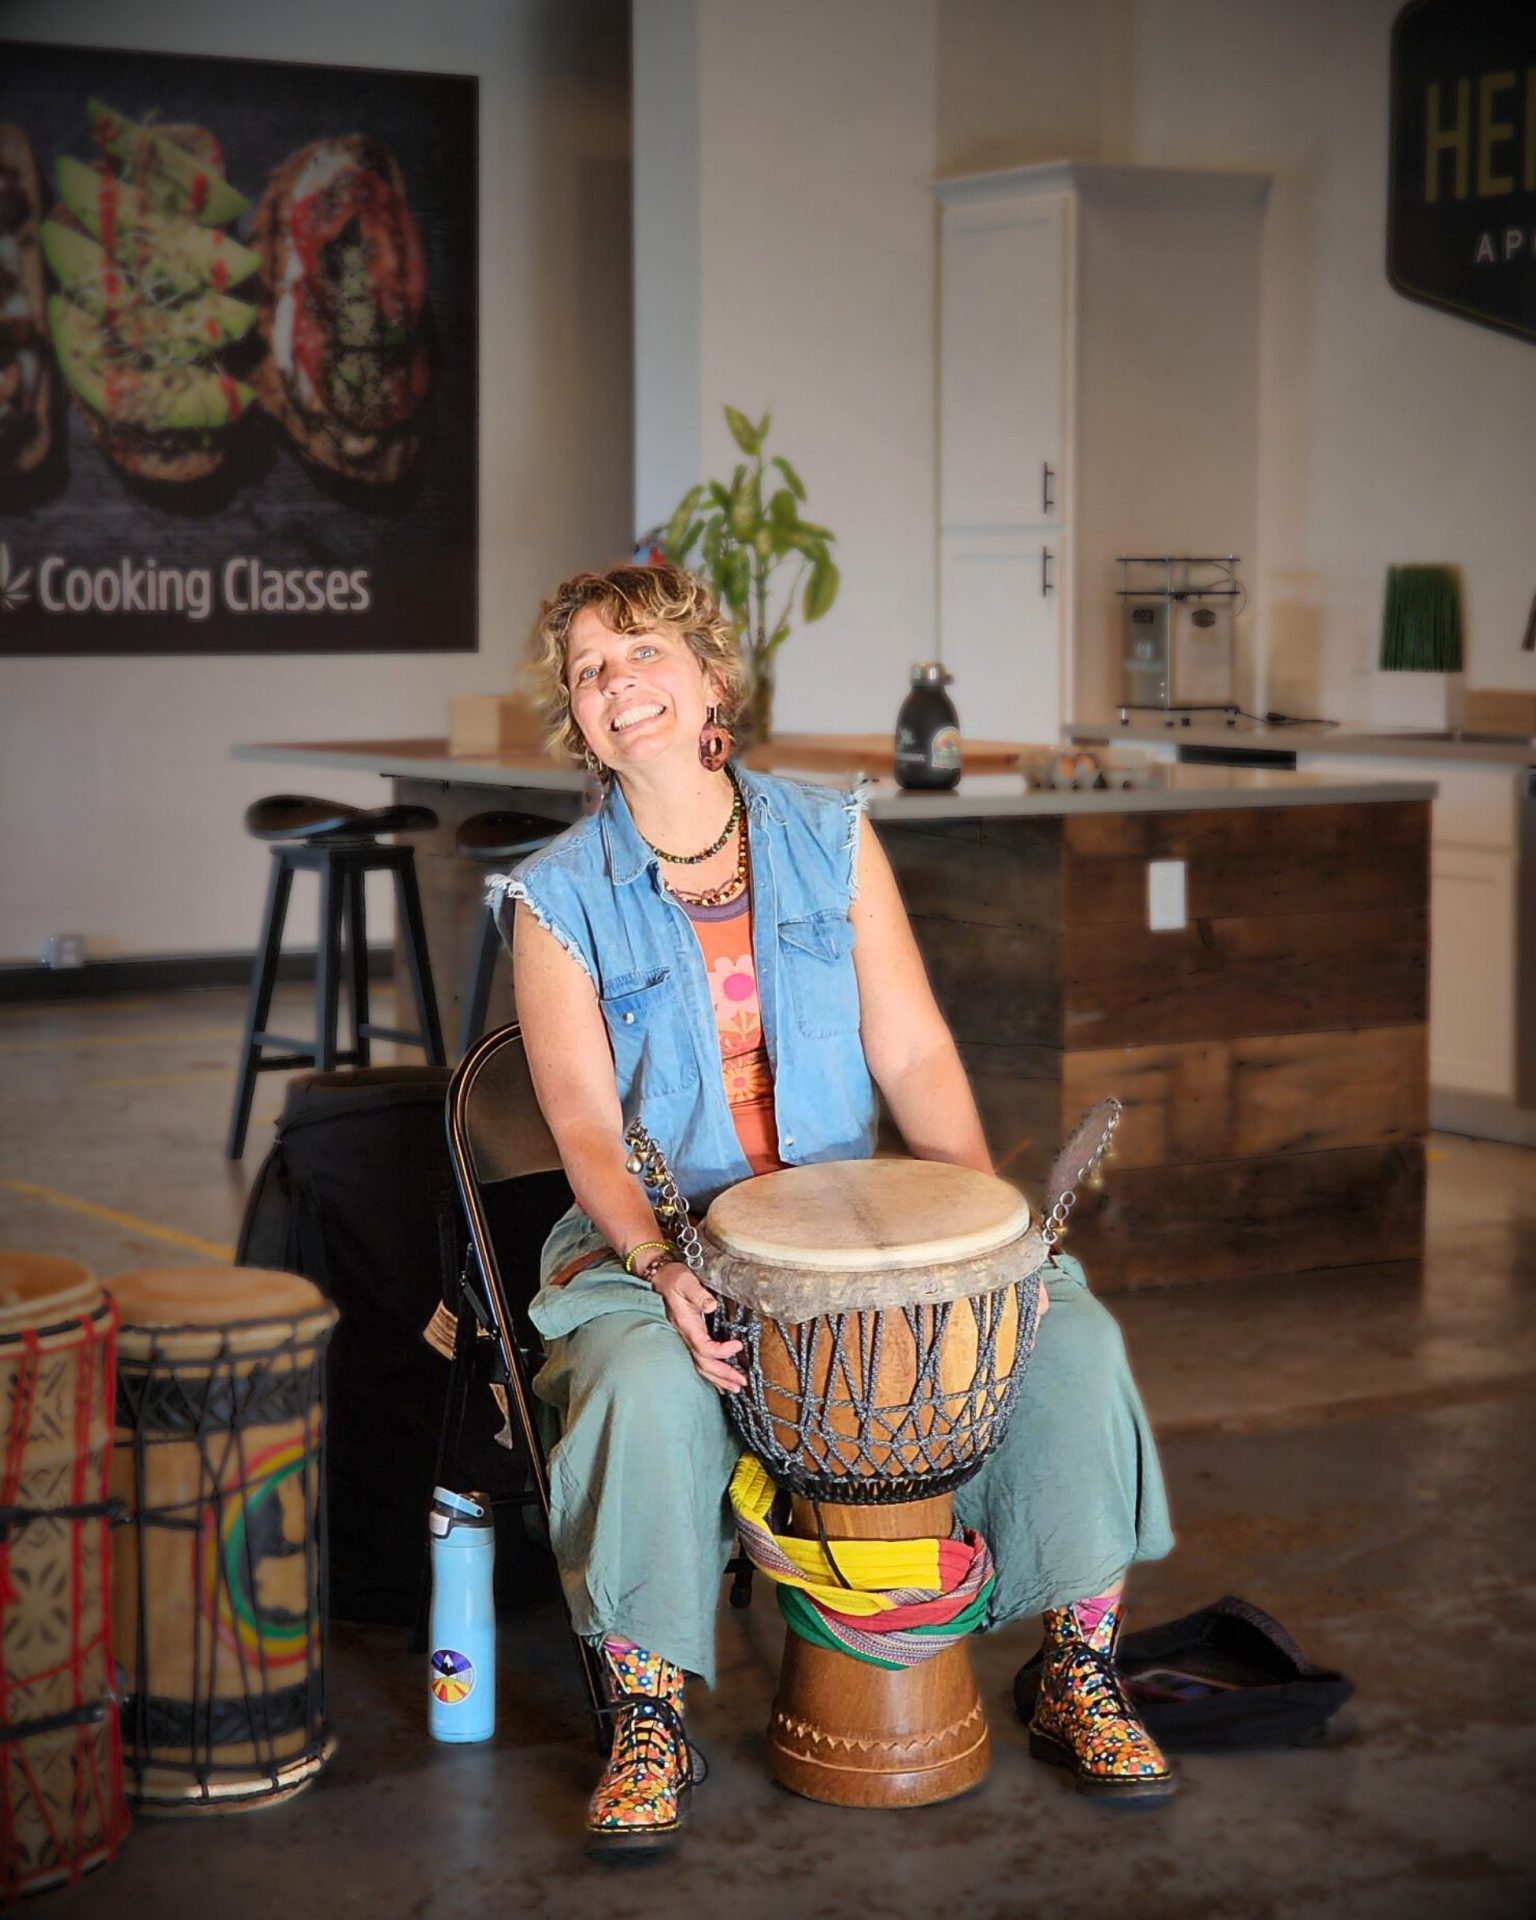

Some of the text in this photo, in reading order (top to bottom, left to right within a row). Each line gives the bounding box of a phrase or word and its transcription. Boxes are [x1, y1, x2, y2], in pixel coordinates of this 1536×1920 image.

[1424, 66, 1536, 203] HE
[1475, 228, 1536, 264] AP
[39, 556, 371, 619] Cooking Classes
